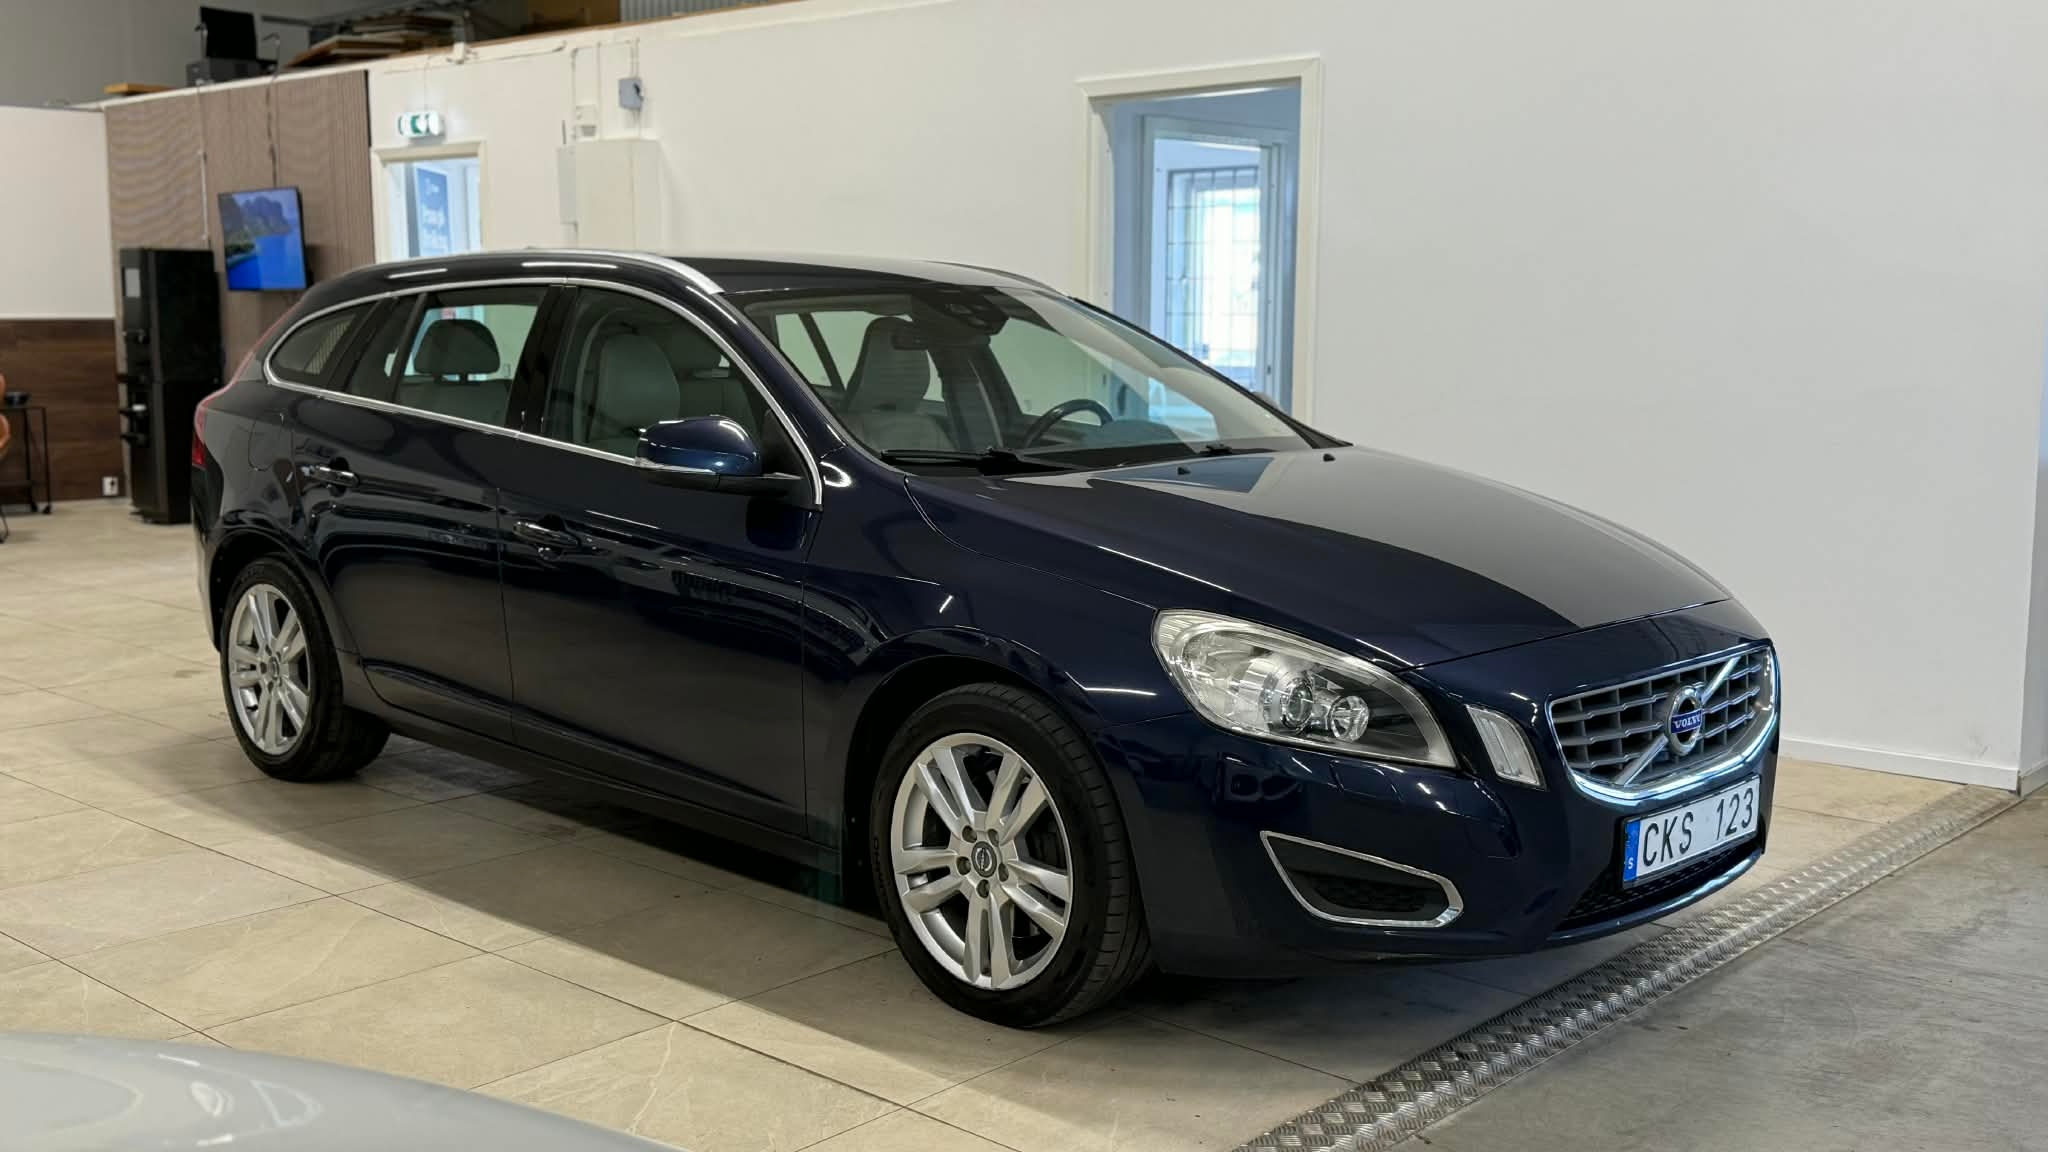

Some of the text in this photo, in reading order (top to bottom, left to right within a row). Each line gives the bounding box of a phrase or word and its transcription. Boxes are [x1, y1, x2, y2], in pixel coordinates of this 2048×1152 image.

[1642, 787, 1754, 867] CKS 123
[1627, 856, 1634, 870] S
